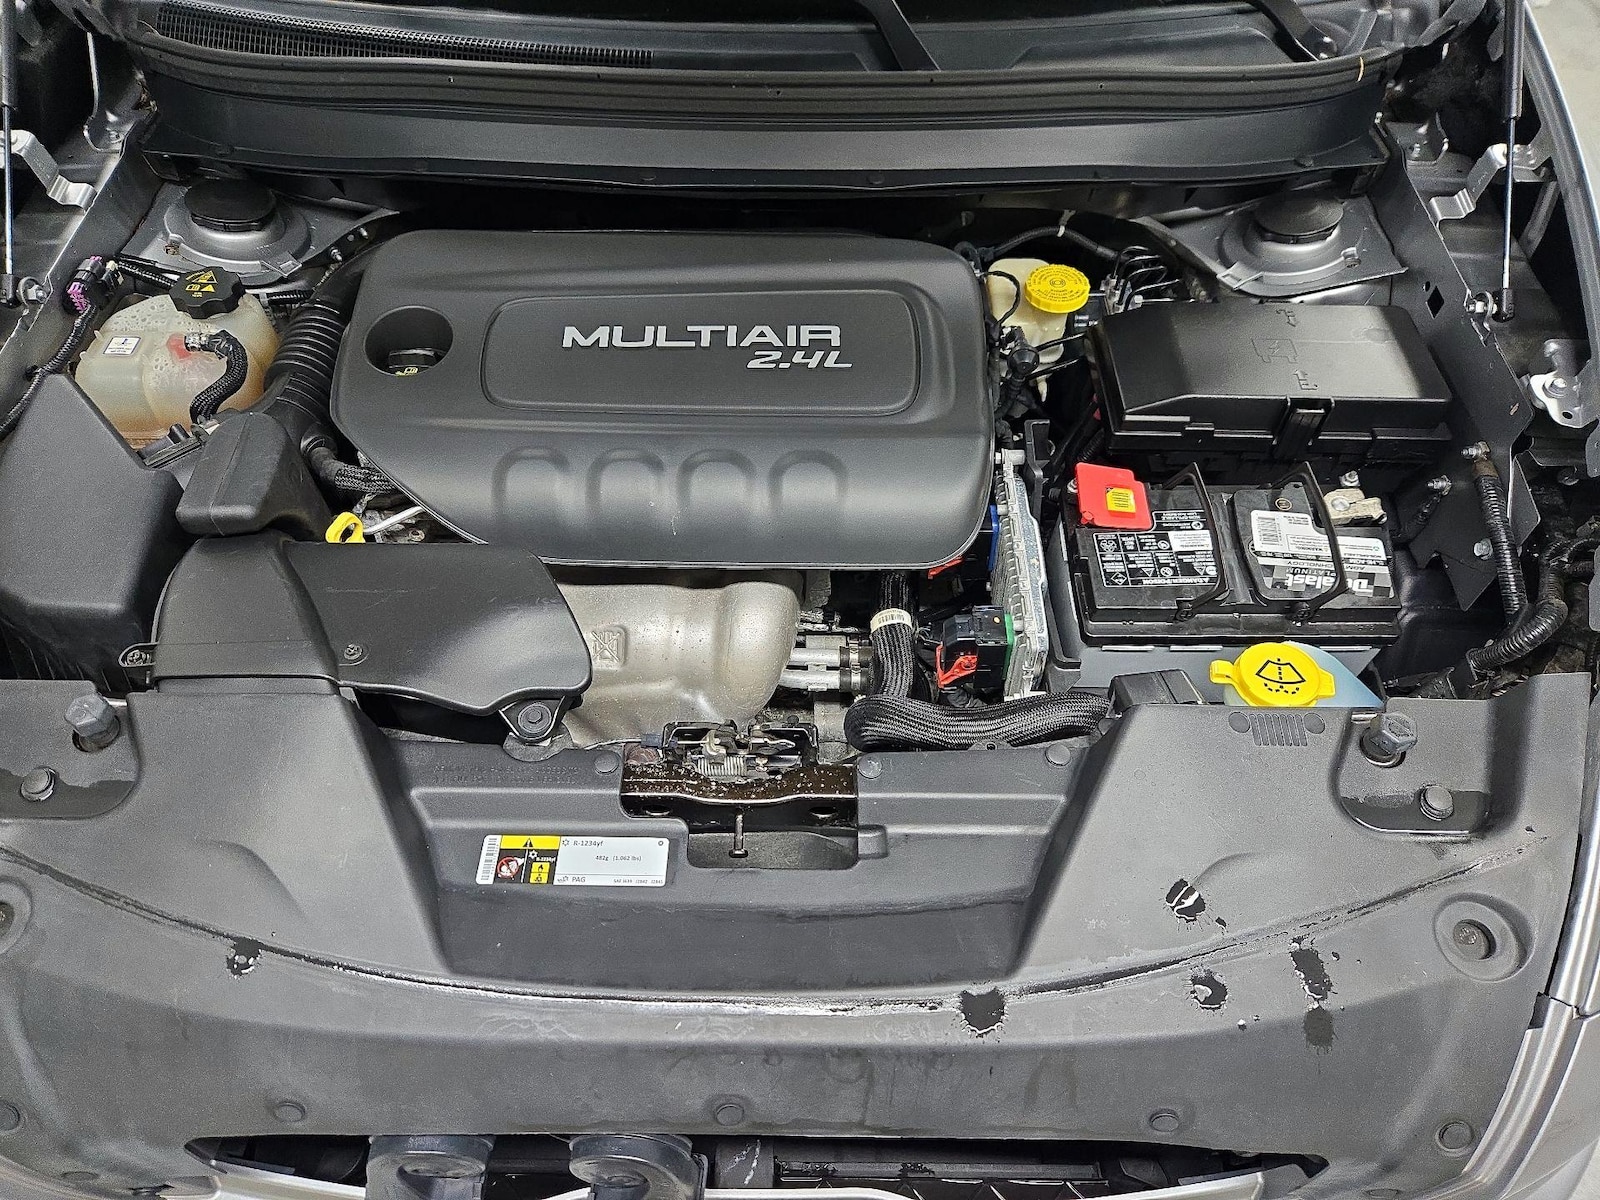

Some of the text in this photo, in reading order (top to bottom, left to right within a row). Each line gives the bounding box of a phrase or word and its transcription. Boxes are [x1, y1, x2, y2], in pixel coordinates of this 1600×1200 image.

[562, 325, 841, 348] MULTIAIR
[746, 350, 853, 369] 2.4L
[1286, 566, 1337, 577] PLATINUM
[573, 840, 603, 848] R-1234yf
